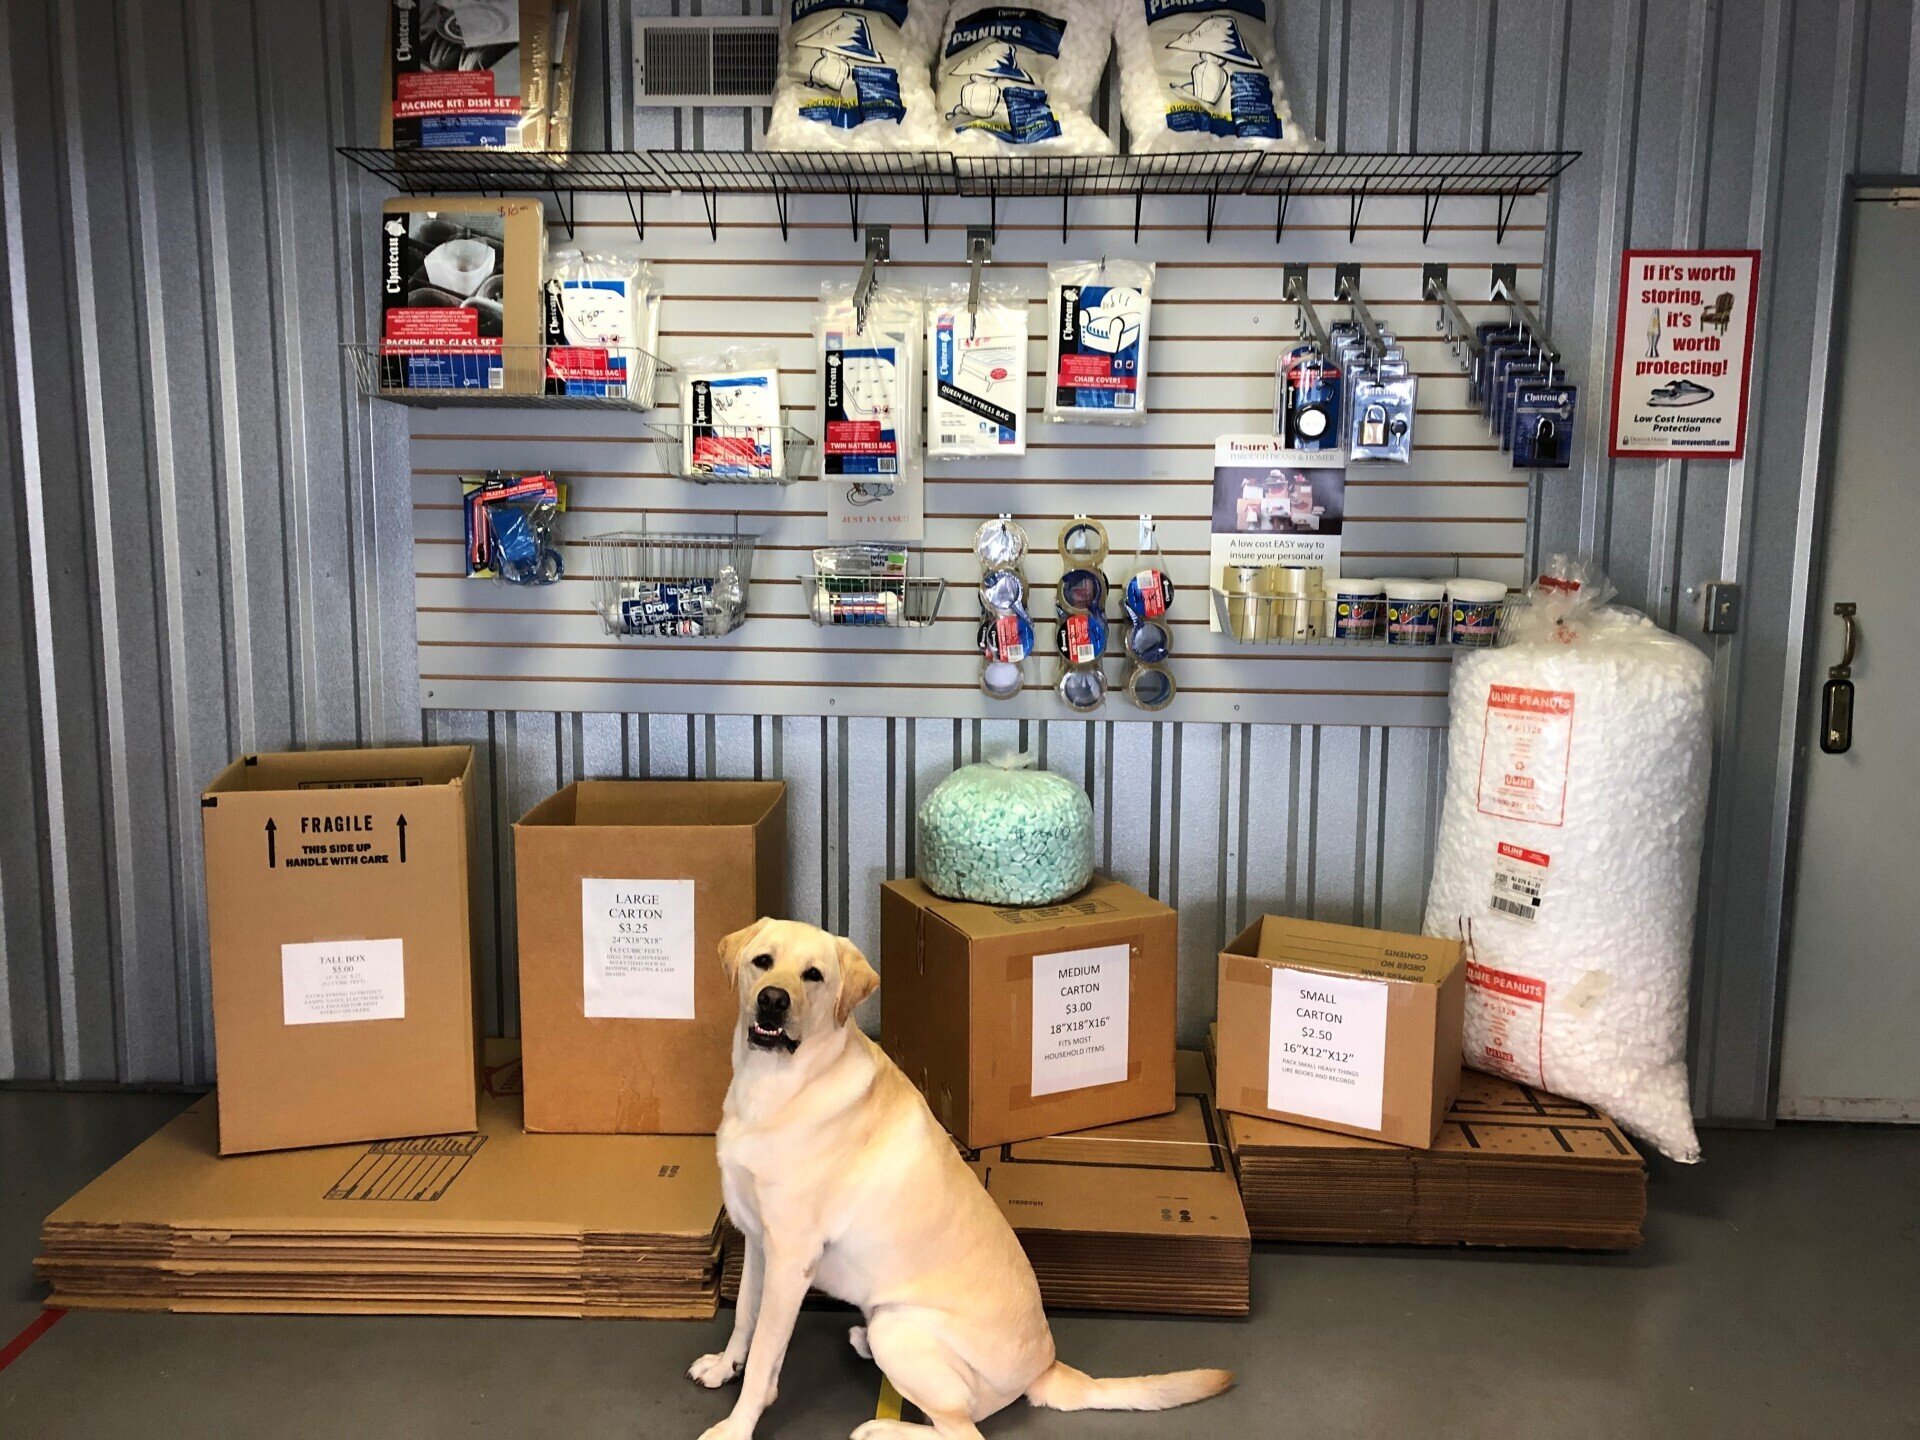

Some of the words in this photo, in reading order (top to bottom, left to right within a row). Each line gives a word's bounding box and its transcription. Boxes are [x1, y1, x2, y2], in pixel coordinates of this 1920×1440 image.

[401, 99, 444, 111] PACKING
[467, 98, 491, 109] DISH
[494, 98, 511, 109] SET
[386, 237, 402, 294] Chateau
[1643, 265, 1654, 280] If
[1659, 265, 1683, 281] it's
[1688, 265, 1736, 281] worth
[1642, 288, 1704, 306] storing,
[1063, 301, 1075, 340] Chateau
[1667, 312, 1692, 328] it's
[1673, 336, 1721, 351] worth
[1636, 359, 1729, 377] protecting!
[1096, 376, 1121, 384] COVERS
[828, 367, 838, 407] Chateau
[941, 385, 962, 398] QUEEN
[962, 393, 995, 414] MATTRESS
[996, 408, 1010, 421] BAG
[1524, 393, 1558, 402] Chateau
[1634, 415, 1652, 423] Low
[1655, 414, 1675, 423] Cost
[1676, 414, 1722, 424] Insurance
[1653, 424, 1701, 433] Protection
[830, 442, 847, 450] TWIN
[848, 442, 878, 450] MATTRESS
[879, 442, 892, 450] BAG
[1230, 441, 1269, 451] Insure
[1672, 438, 1730, 447] insureyourstuff.com
[1230, 539, 1236, 547] A
[1238, 539, 1252, 547] low
[1274, 540, 1295, 548] EASY
[1297, 541, 1314, 549] way
[1257, 553, 1276, 561] your
[1277, 552, 1313, 561] personal
[645, 603, 669, 613] Drop
[1491, 691, 1517, 704] ULINE
[1506, 776, 1533, 788] ULINE
[301, 815, 373, 833] FRAGILE
[302, 845, 327, 854] THIS
[329, 844, 354, 853] SIDE
[356, 843, 371, 853] UP
[1502, 844, 1523, 857] ULINE
[285, 857, 329, 868] HANDLE
[330, 856, 358, 866] WITH
[360, 855, 388, 865] CARE
[616, 894, 659, 905] LARGE
[609, 908, 663, 919] CARTON
[619, 923, 648, 935] $3.25
[319, 956, 343, 964] TALL
[346, 955, 366, 963] BOX
[1384, 949, 1429, 961] CONTENTS
[332, 965, 354, 973] $5.00
[1058, 964, 1100, 979] MEDIUM
[1360, 968, 1384, 978] NAME
[1397, 961, 1426, 972] ORDER
[1386, 973, 1423, 983] SHIPPERS
[1060, 982, 1100, 996] CARTON
[1493, 972, 1543, 998] PEANUTS
[1300, 989, 1337, 1004] SMALL
[1065, 1001, 1092, 1015] $3.00
[1296, 1007, 1343, 1024] CARTON
[1050, 1016, 1110, 1035] 18"X18"X16"
[1301, 1026, 1332, 1041] $2.50
[1058, 1039, 1072, 1047] FITS
[1073, 1036, 1092, 1045] MOST
[1044, 1047, 1084, 1060] HOUSEHOLD
[1085, 1045, 1105, 1054] ITEMS
[1283, 1042, 1355, 1063] 16"X12"X12"
[1486, 1048, 1513, 1062] ULINE
[1282, 1058, 1297, 1066] PACK
[1297, 1061, 1316, 1070] SMALL
[1317, 1064, 1336, 1073] HEAVY
[1338, 1068, 1359, 1077] THINGS
[1294, 1069, 1313, 1078] BOOKS
[1315, 1072, 1328, 1080] AND
[1328, 1075, 1355, 1085] RECORDS
